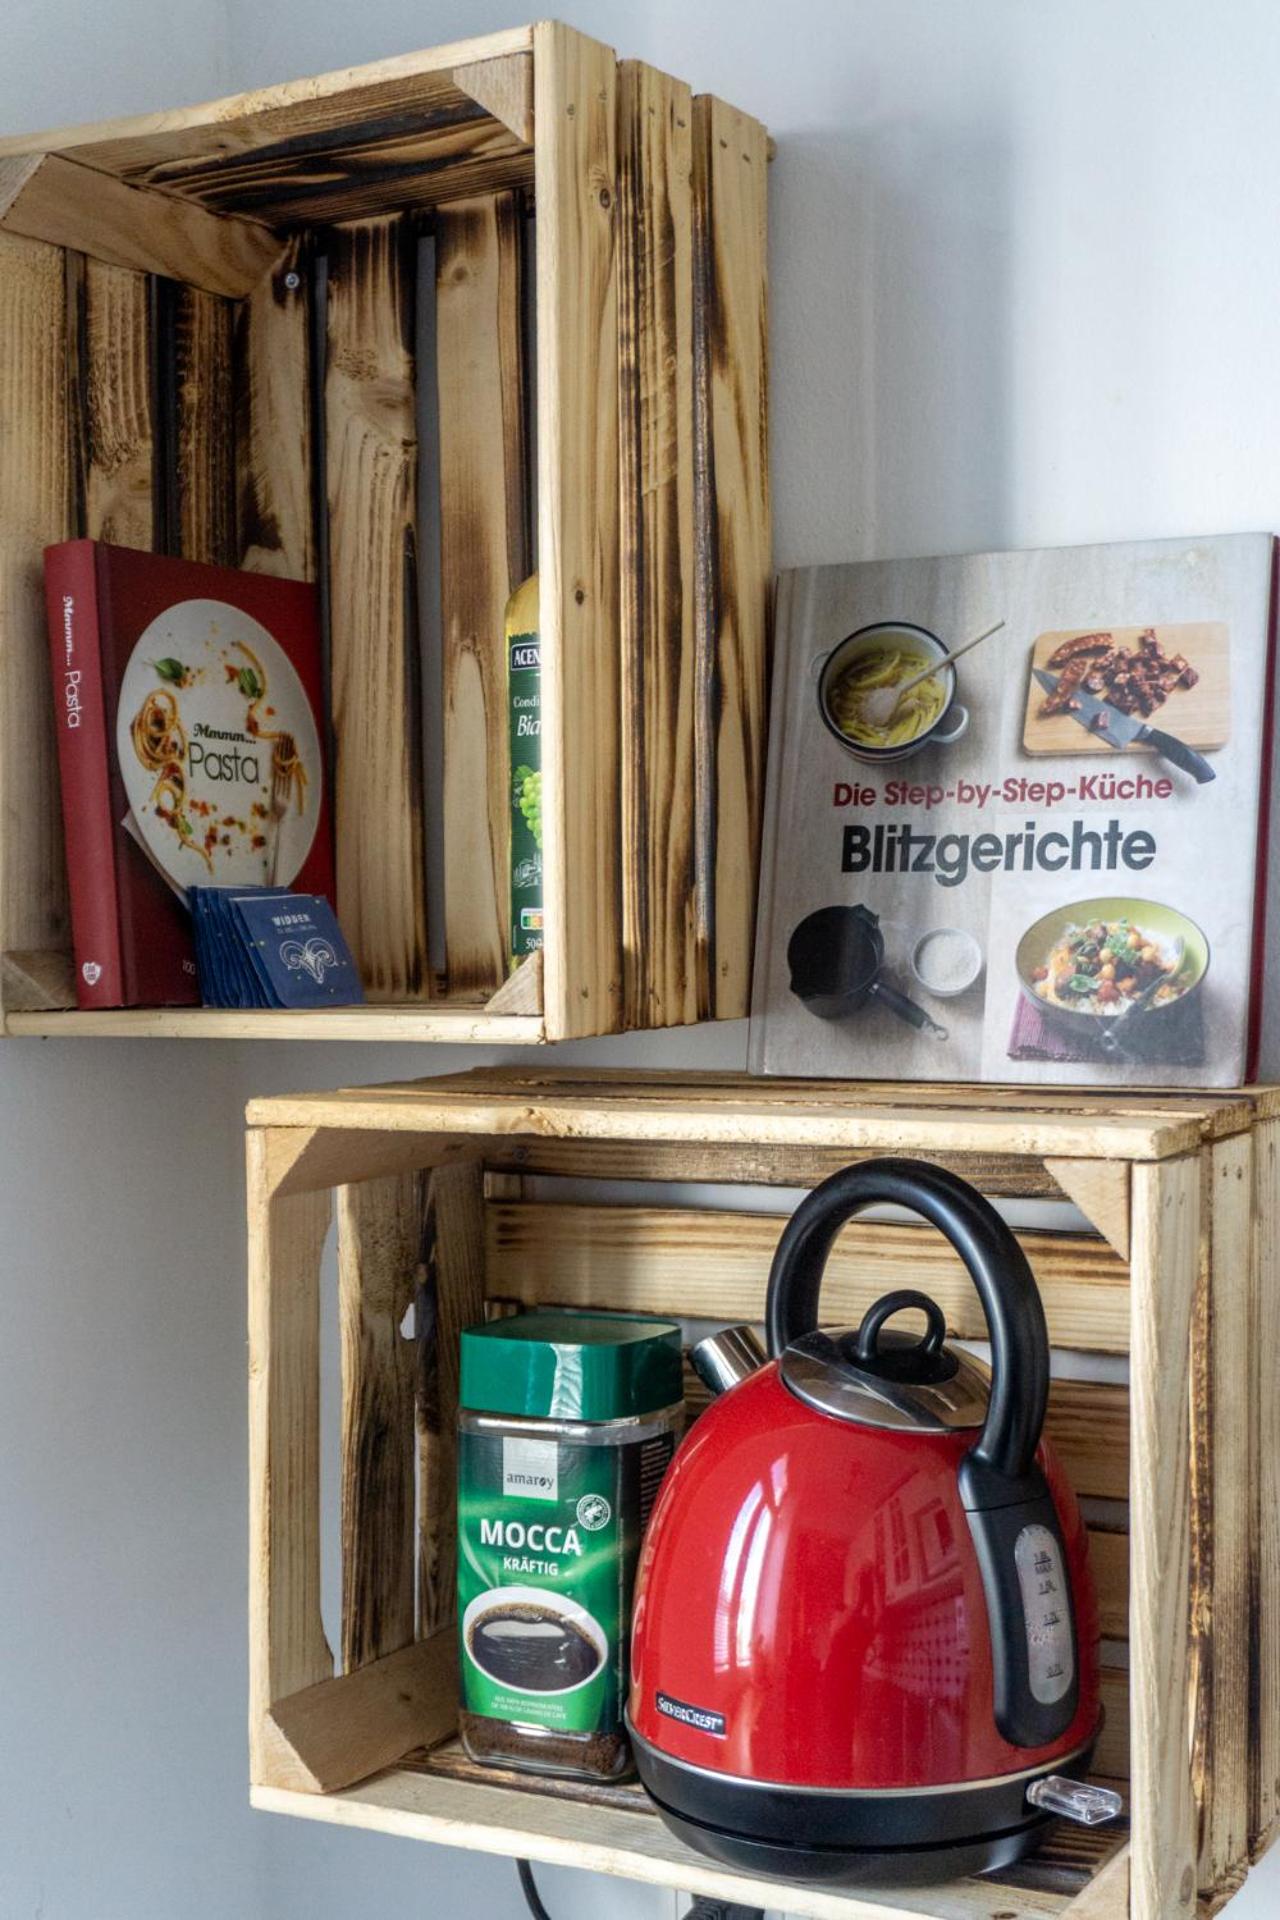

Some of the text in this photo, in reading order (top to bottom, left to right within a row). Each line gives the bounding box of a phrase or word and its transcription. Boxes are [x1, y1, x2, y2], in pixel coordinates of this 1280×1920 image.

[64, 671, 83, 729] Pasta
[188, 742, 260, 784] Pasta
[833, 774, 1174, 810] Die Step-by-Step-Küche
[841, 819, 1157, 888] Blitzgerichte
[506, 1473, 554, 1489] amaroy
[479, 1518, 583, 1556] MOCCA
[503, 1556, 559, 1576] KRÄFTIG
